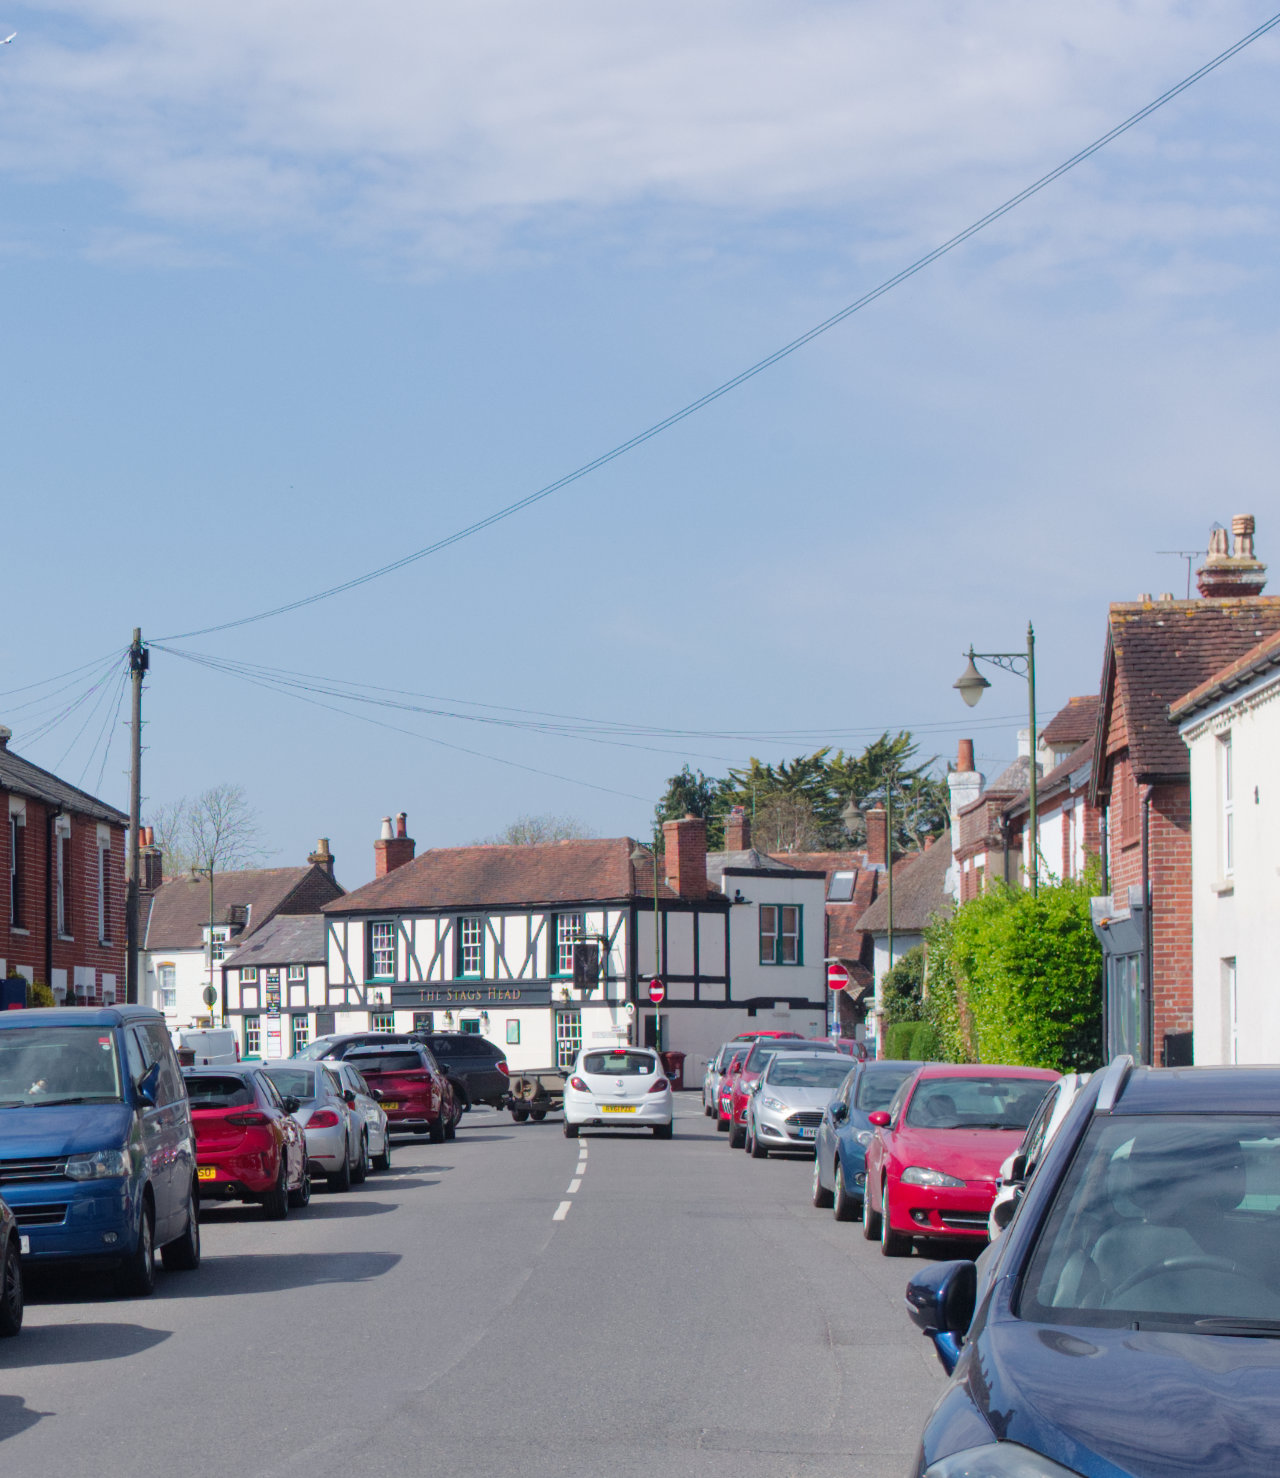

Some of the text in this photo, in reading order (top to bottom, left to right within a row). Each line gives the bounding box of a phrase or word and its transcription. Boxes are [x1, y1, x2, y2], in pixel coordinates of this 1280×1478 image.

[419, 987, 521, 1001] THE STAGS HEAD
[198, 1168, 211, 1177] SO
